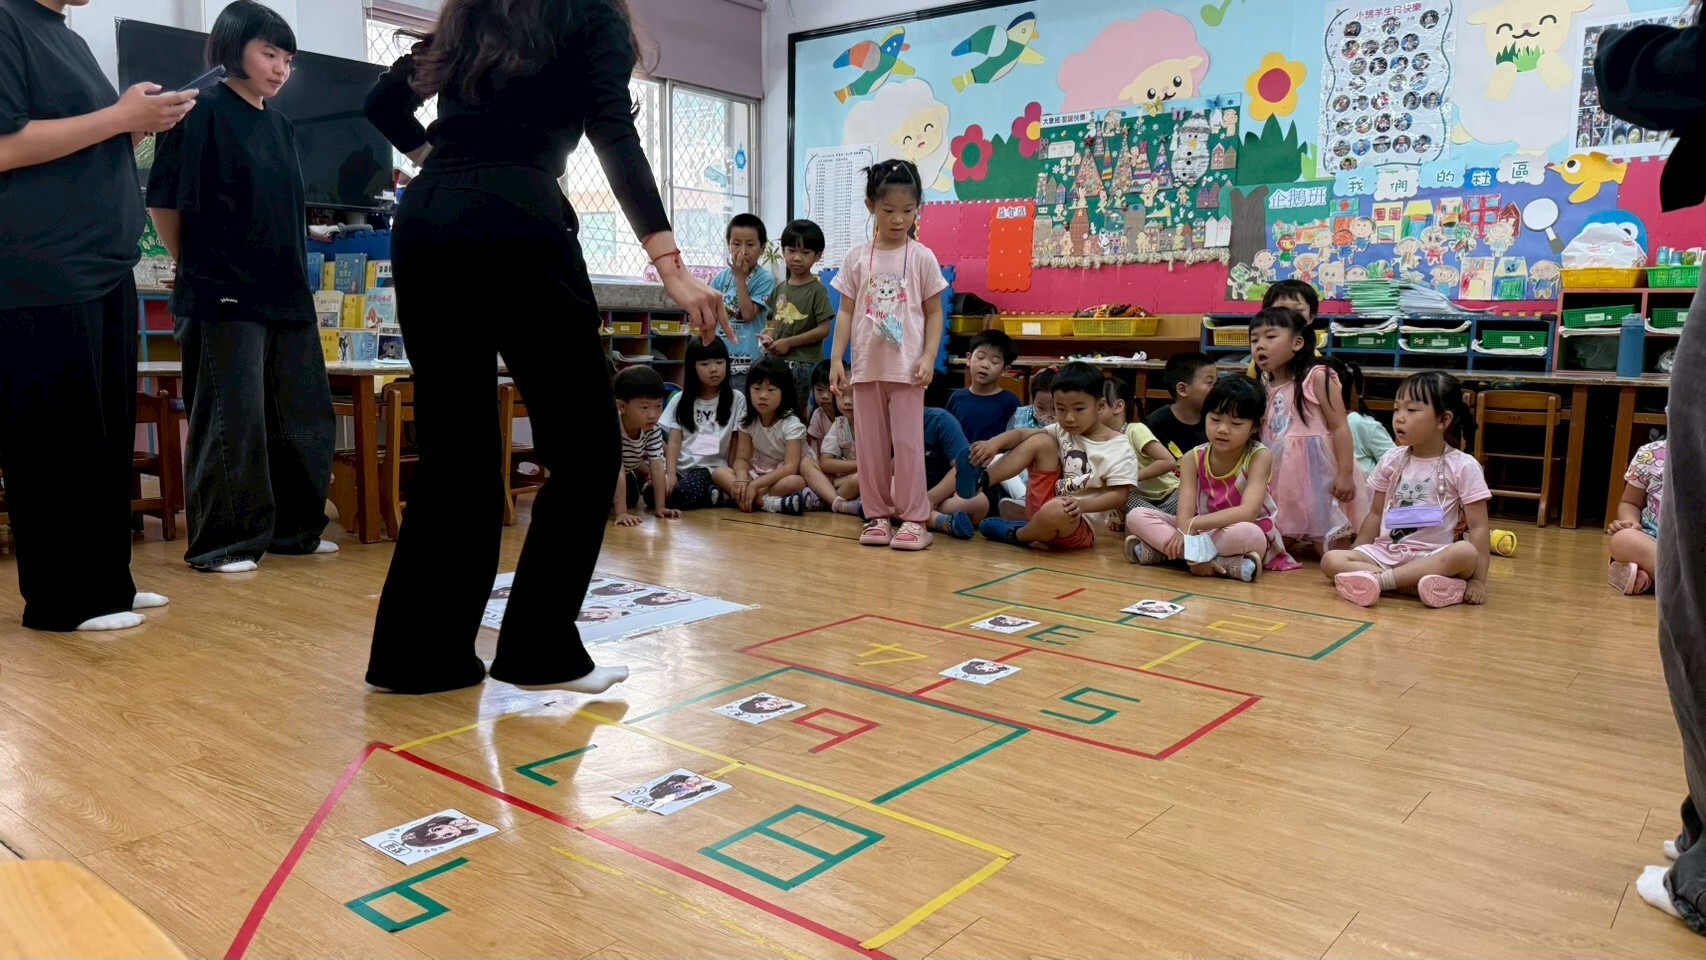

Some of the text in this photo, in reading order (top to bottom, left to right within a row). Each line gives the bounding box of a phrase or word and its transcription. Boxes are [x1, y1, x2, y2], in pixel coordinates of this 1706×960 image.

[1355, 3, 1422, 19] 小綿羊生日快樂
[1349, 160, 1530, 193] 我們的社區
[1270, 187, 1327, 206] 企鵝班
[997, 206, 1026, 218] 益智區
[696, 803, 887, 892] 8
